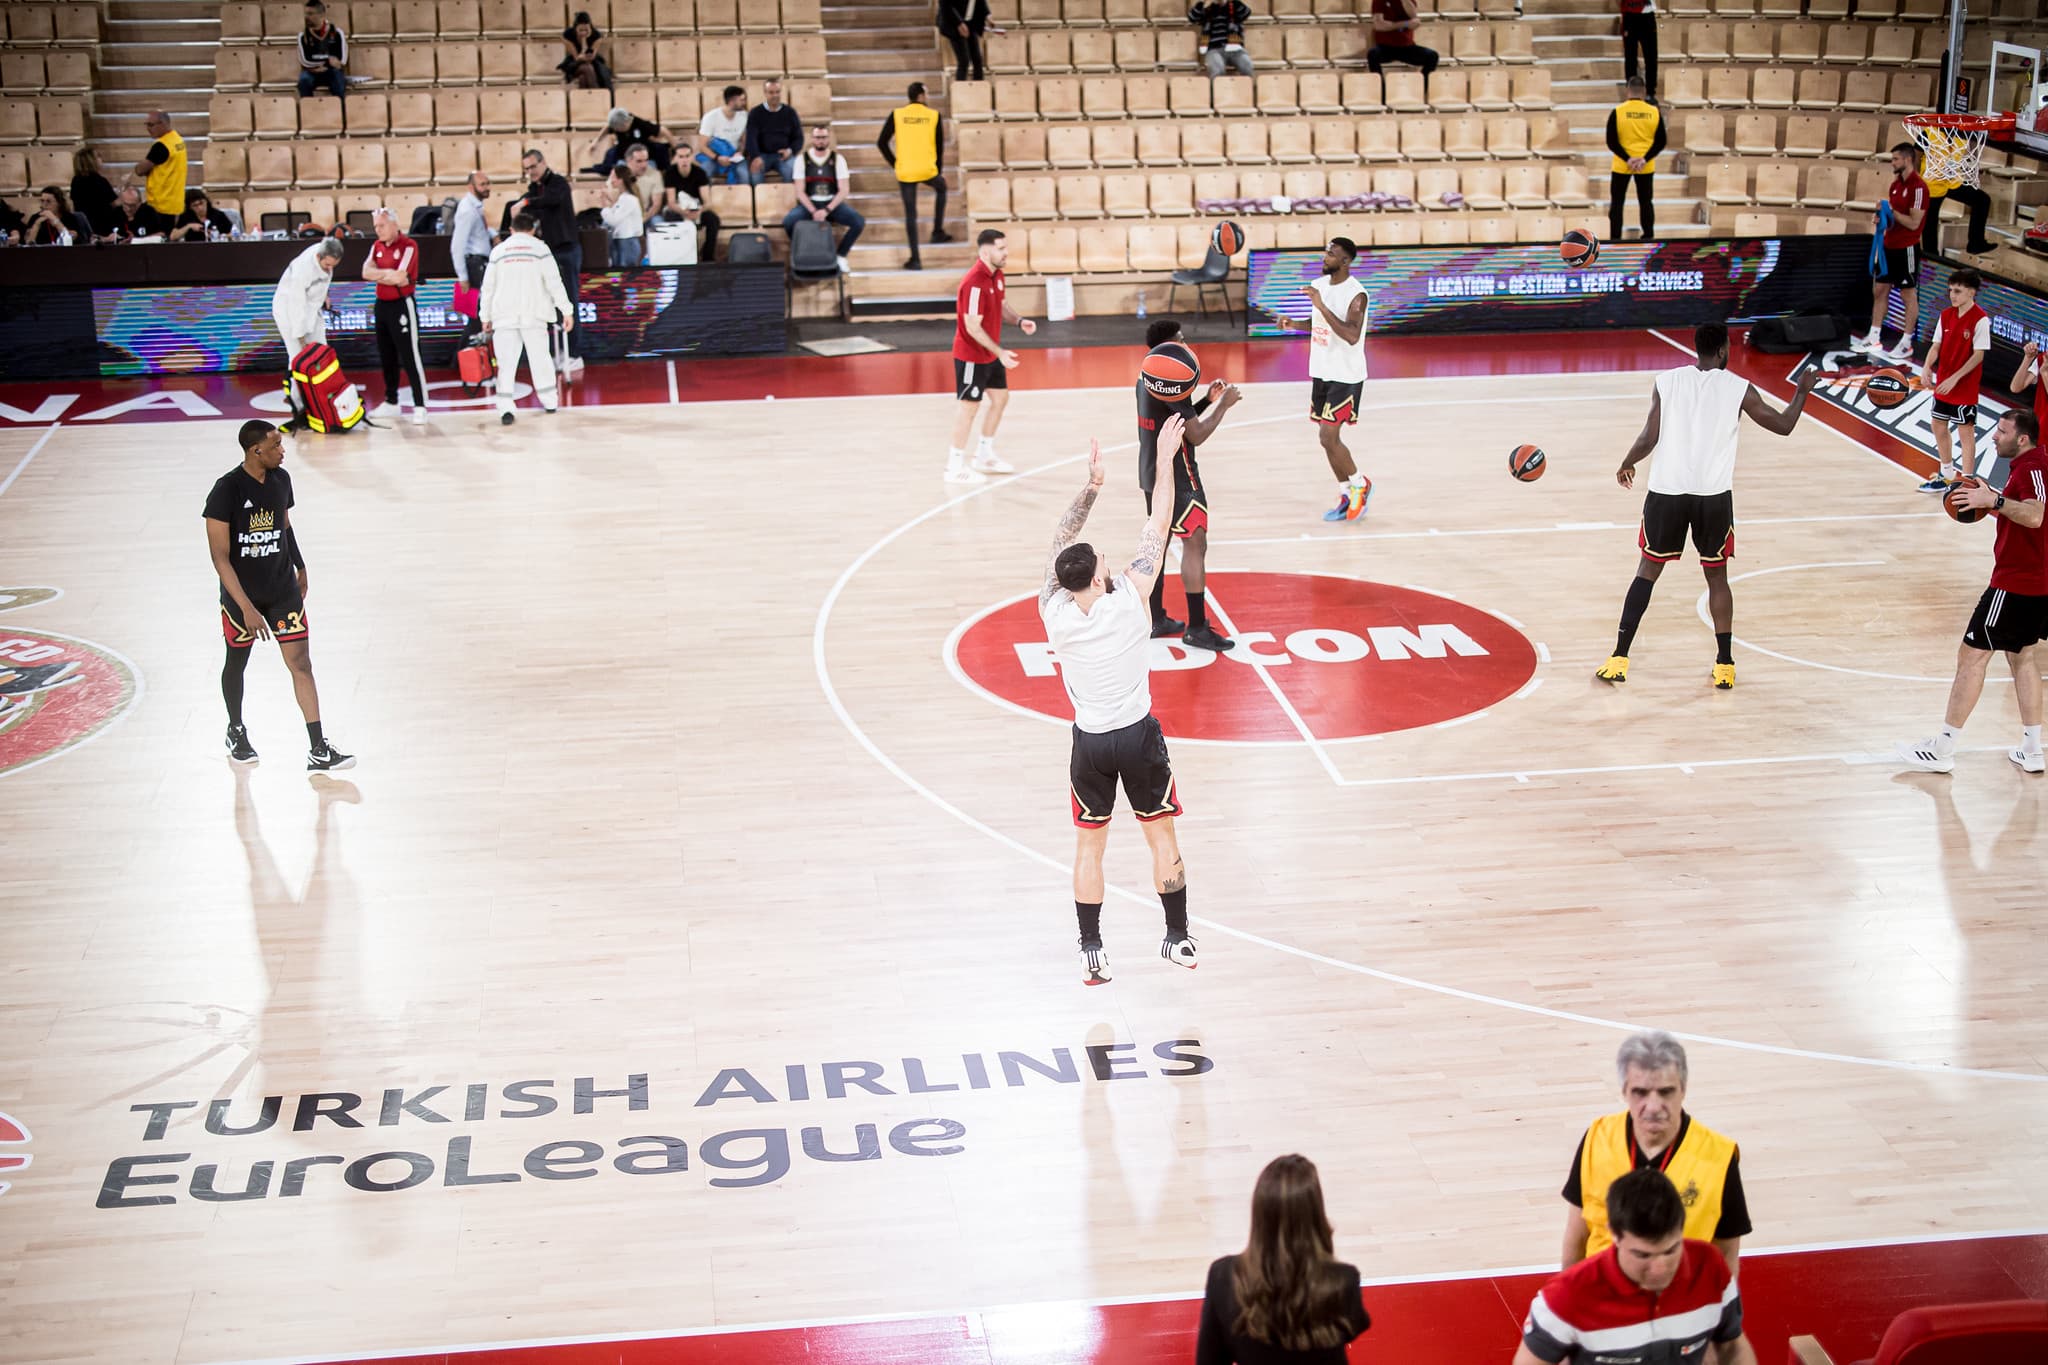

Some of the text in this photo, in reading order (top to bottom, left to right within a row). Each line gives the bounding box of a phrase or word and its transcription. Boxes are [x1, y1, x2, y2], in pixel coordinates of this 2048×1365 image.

[1428, 270, 1704, 296] LOCATION GESTION VENTE SERVICES
[1993, 314, 2024, 343] GESTION
[1013, 623, 1491, 677] FDCOM
[129, 1039, 1216, 1142] TURKISH AIRLINES
[96, 1118, 966, 1209] EuroLeague
